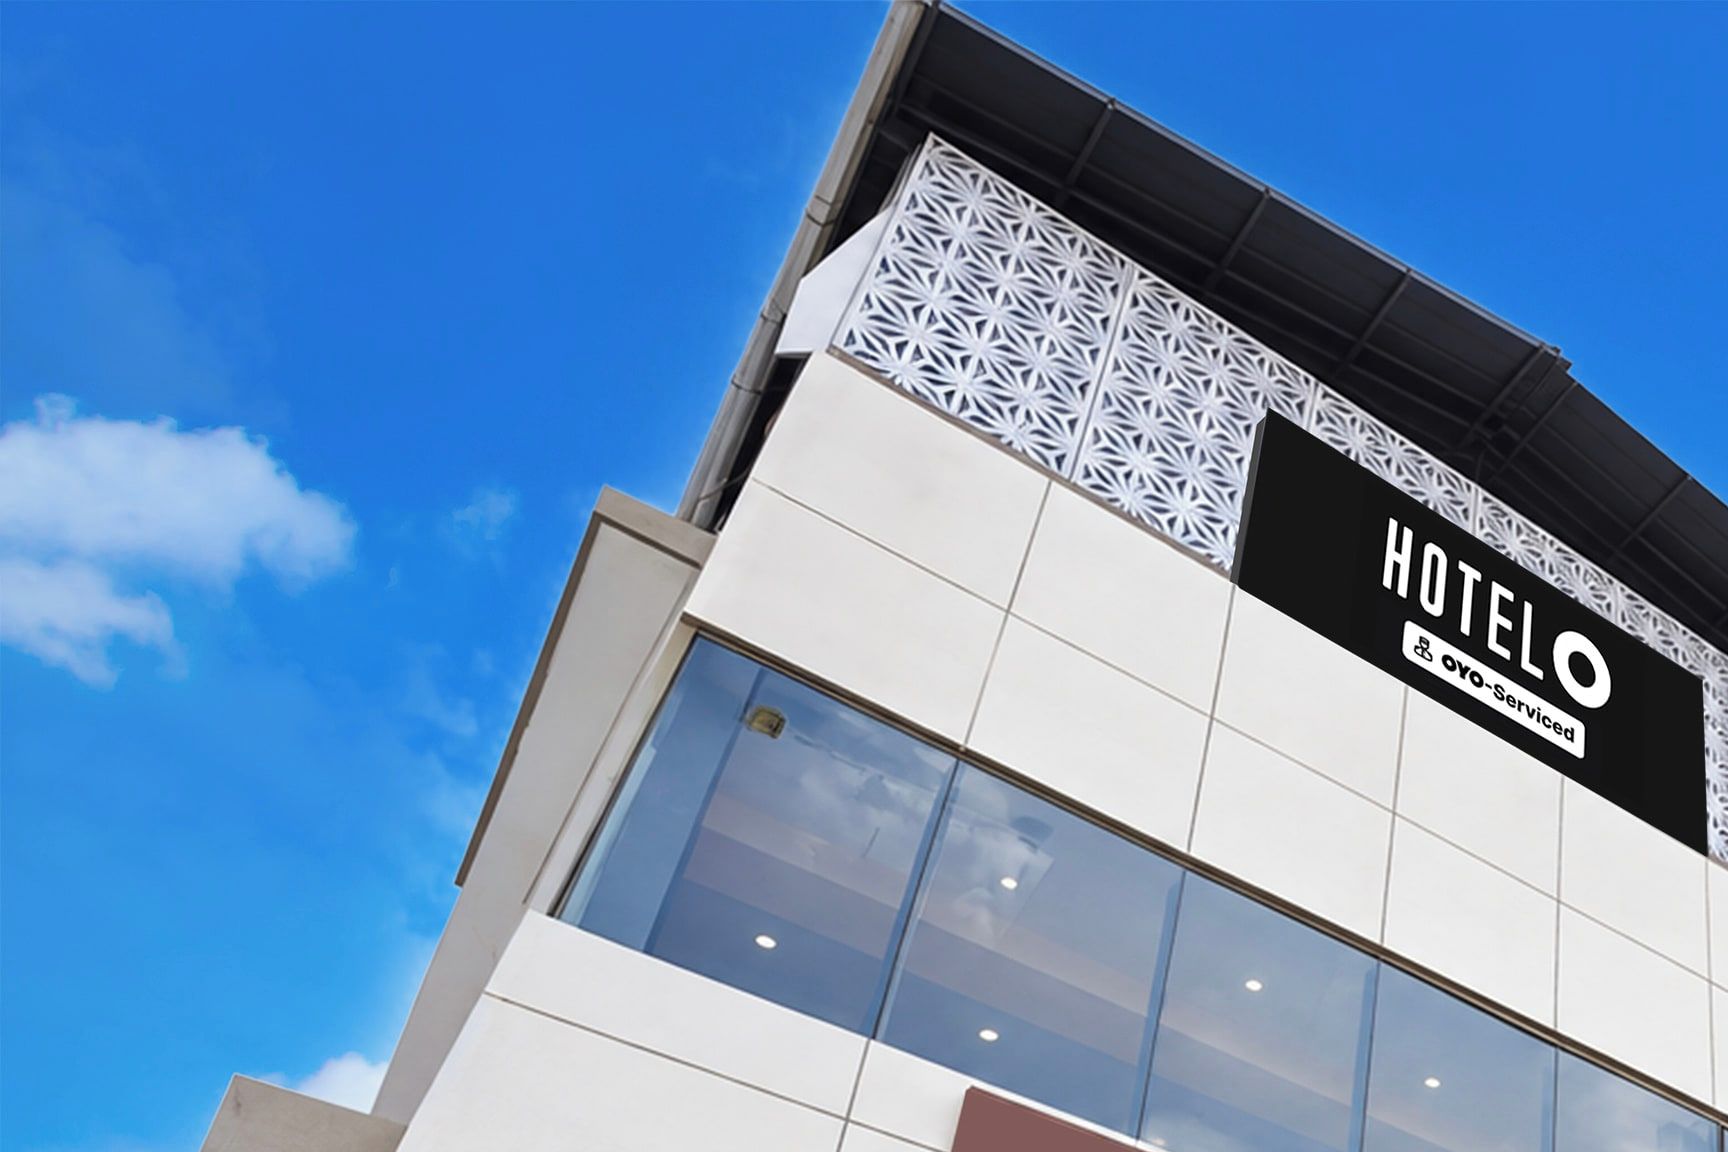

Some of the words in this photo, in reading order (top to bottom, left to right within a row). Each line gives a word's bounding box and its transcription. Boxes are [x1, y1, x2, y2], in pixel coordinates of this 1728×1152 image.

[1382, 517, 1544, 681] HOTEL
[1552, 630, 1612, 709] O
[1441, 654, 1575, 744] OYO-Serviced
